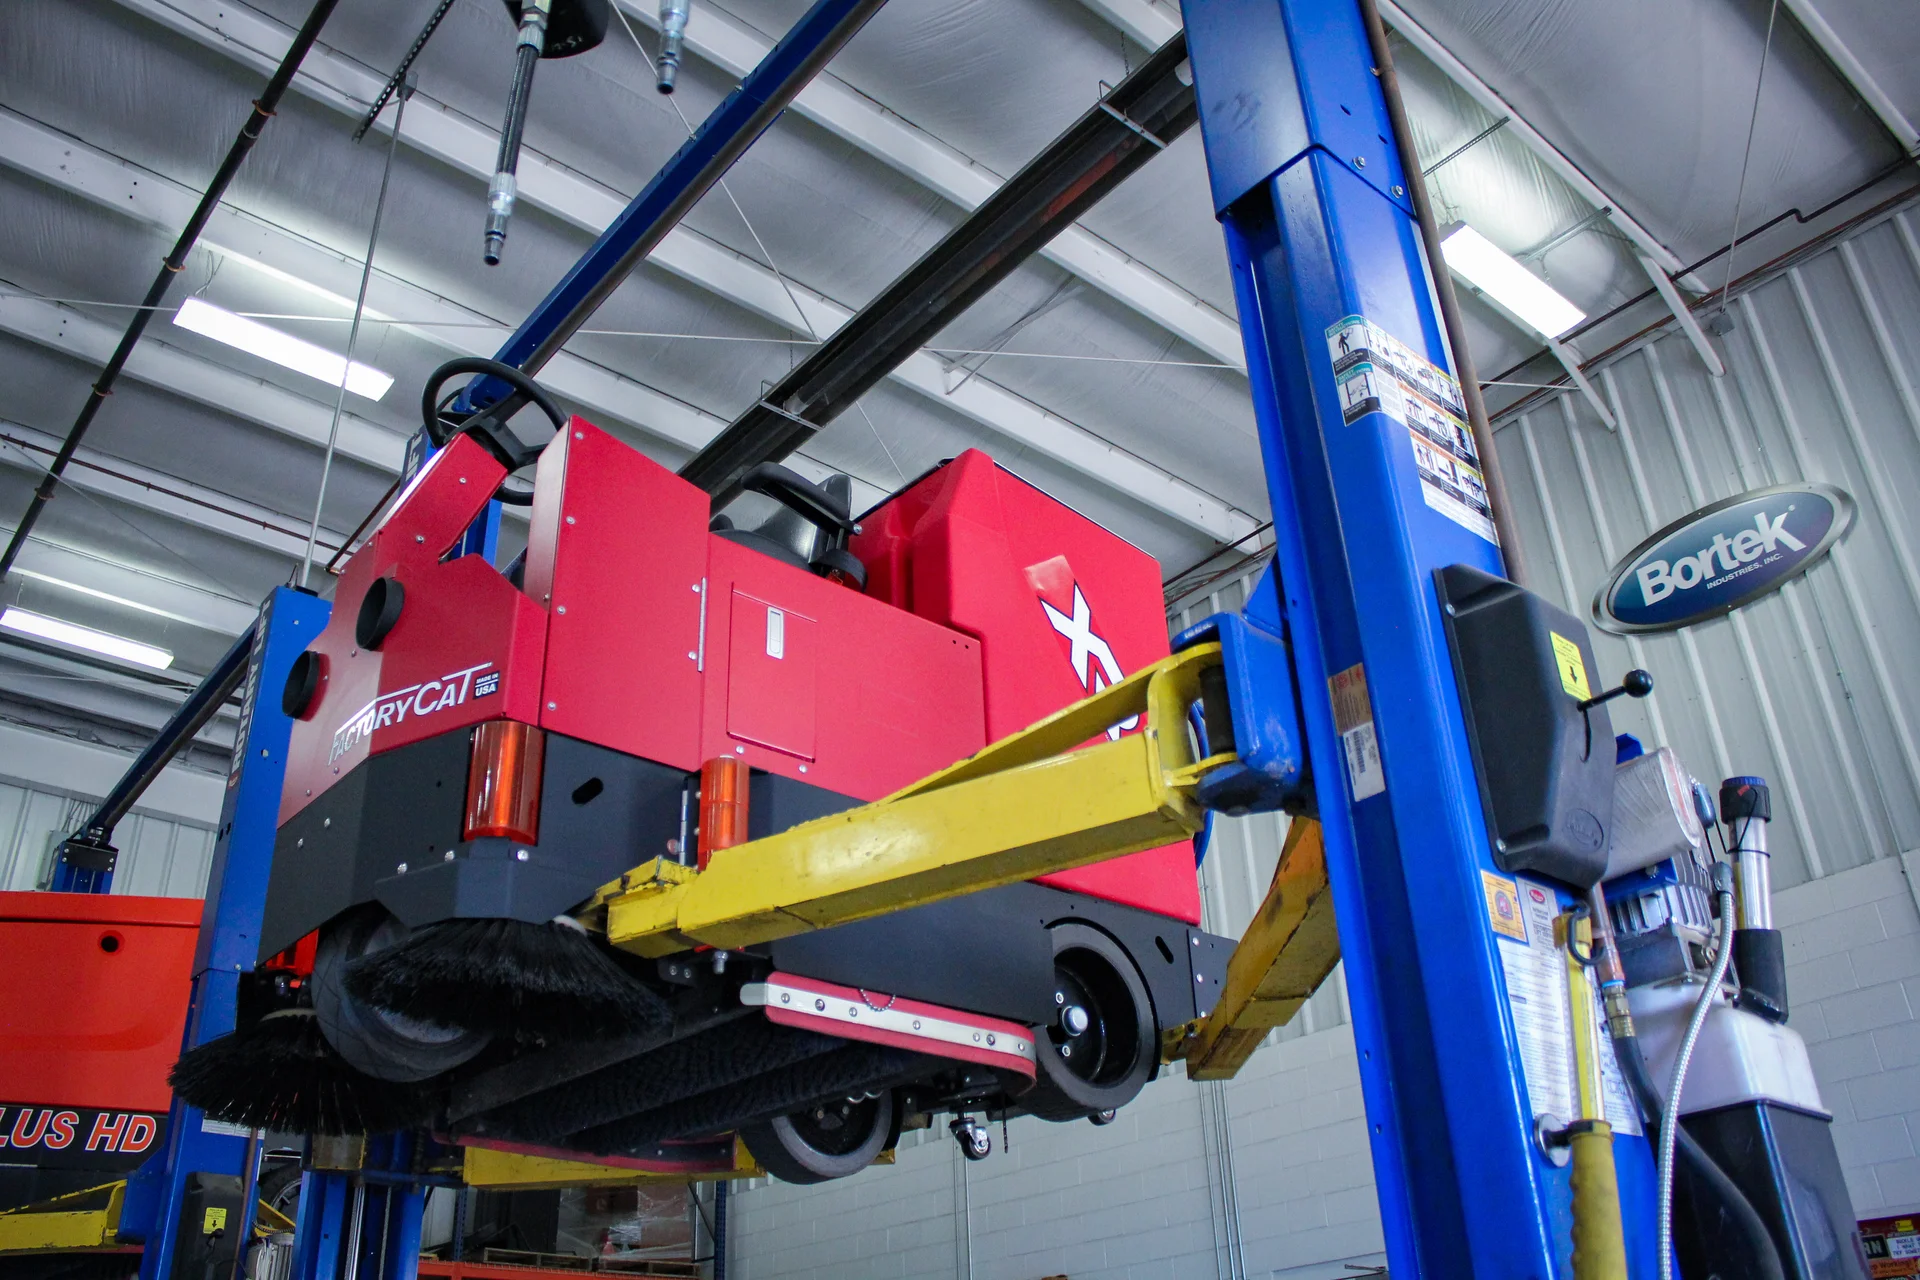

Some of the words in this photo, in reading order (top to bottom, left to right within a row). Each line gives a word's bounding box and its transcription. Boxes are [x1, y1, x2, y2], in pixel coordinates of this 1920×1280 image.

[404, 433, 423, 482] IFT
[1706, 561, 1763, 590] INDUSTRIES,
[1763, 554, 1784, 566] INC.
[231, 662, 260, 773] ROTARY
[253, 599, 272, 656] LIFT
[475, 682, 497, 697] USA
[476, 674, 492, 684] MADE
[85, 1112, 157, 1153] HD
